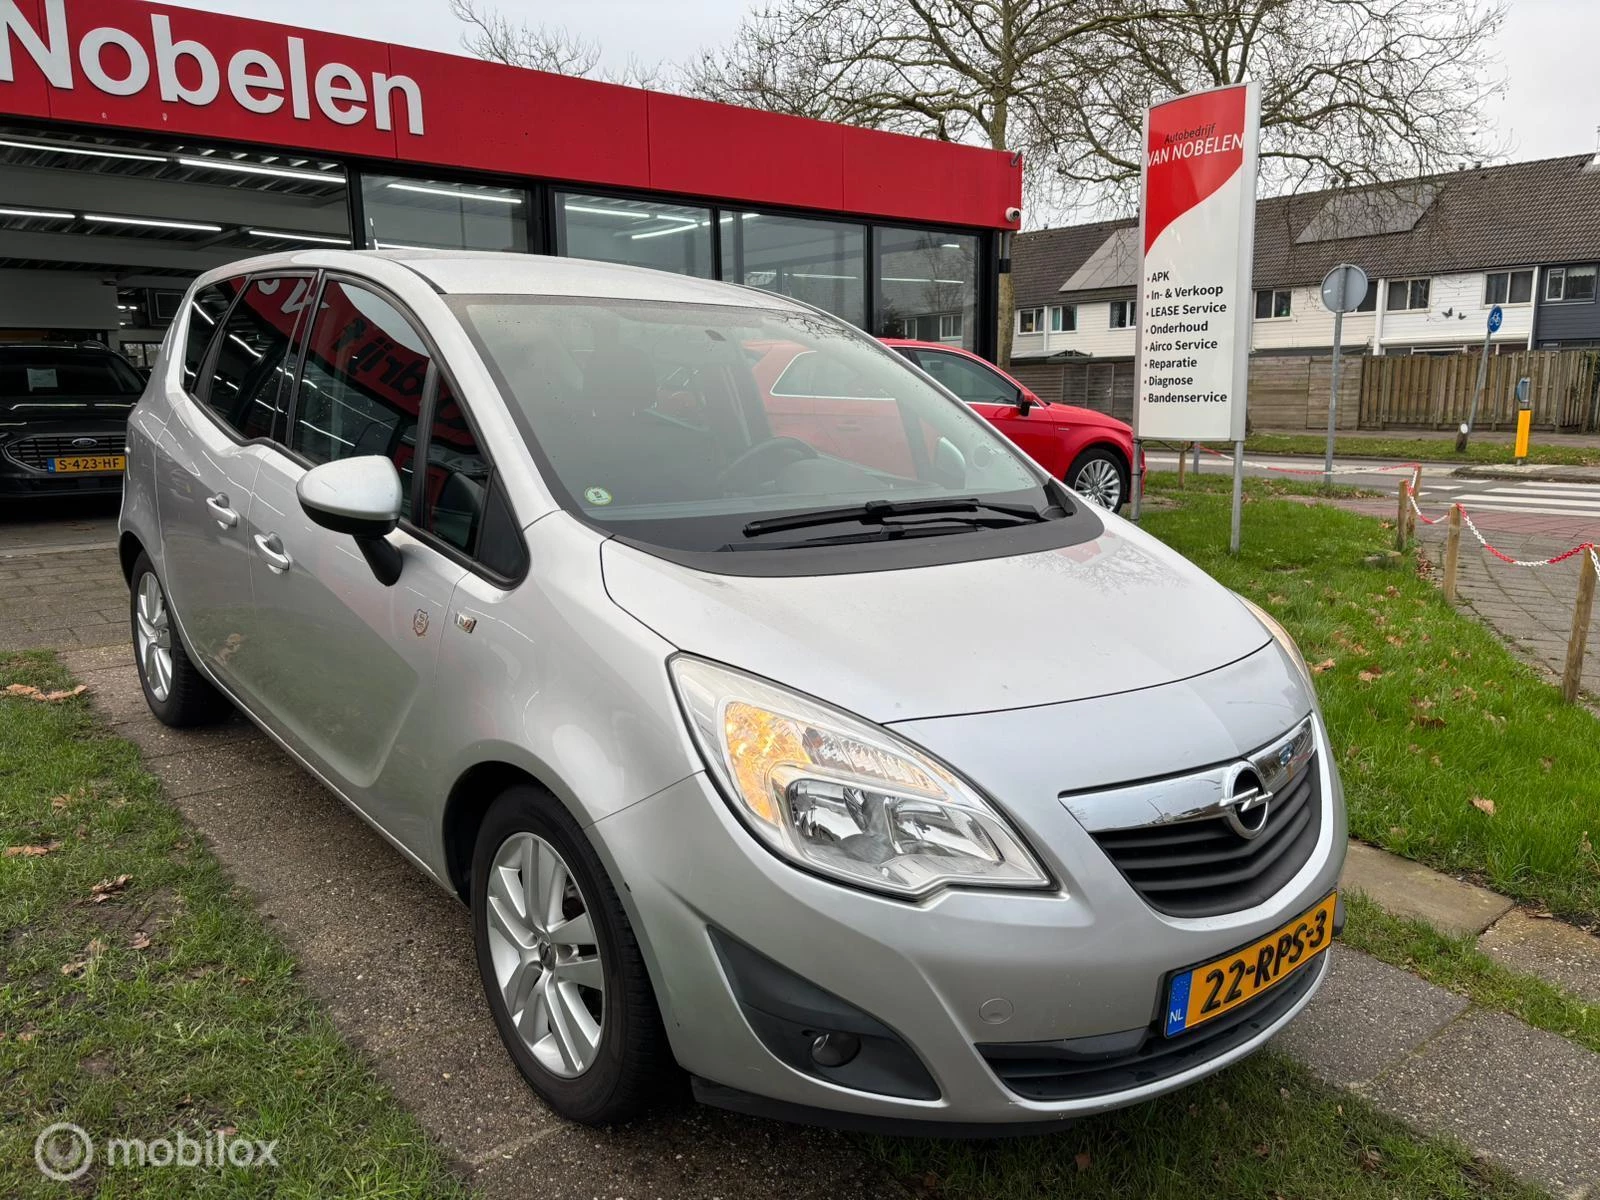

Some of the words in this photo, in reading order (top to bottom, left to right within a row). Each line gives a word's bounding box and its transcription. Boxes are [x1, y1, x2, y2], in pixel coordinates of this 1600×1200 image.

[0, 0, 425, 135] Nobelen
[1164, 122, 1216, 144] Autobedrijf
[1148, 147, 1170, 167] VAN
[1172, 132, 1245, 161] NOBELEN
[1151, 271, 1170, 283] APK
[1151, 290, 1163, 300] In-
[1165, 288, 1173, 299] &
[1175, 285, 1224, 298] Verkoop
[1151, 305, 1180, 318] LEASE
[1182, 302, 1227, 315] Service
[1150, 320, 1209, 334] Onderhoud
[1149, 341, 1172, 352] Airco
[1175, 338, 1218, 351] Service
[1149, 357, 1198, 371] Reparatie
[1148, 375, 1193, 388] Diagnose
[1148, 391, 1228, 403] Bandenservice
[58, 457, 120, 470] S-423-HF
[1169, 1010, 1184, 1024] NL
[1200, 908, 1327, 1015] 22-RPS-3
